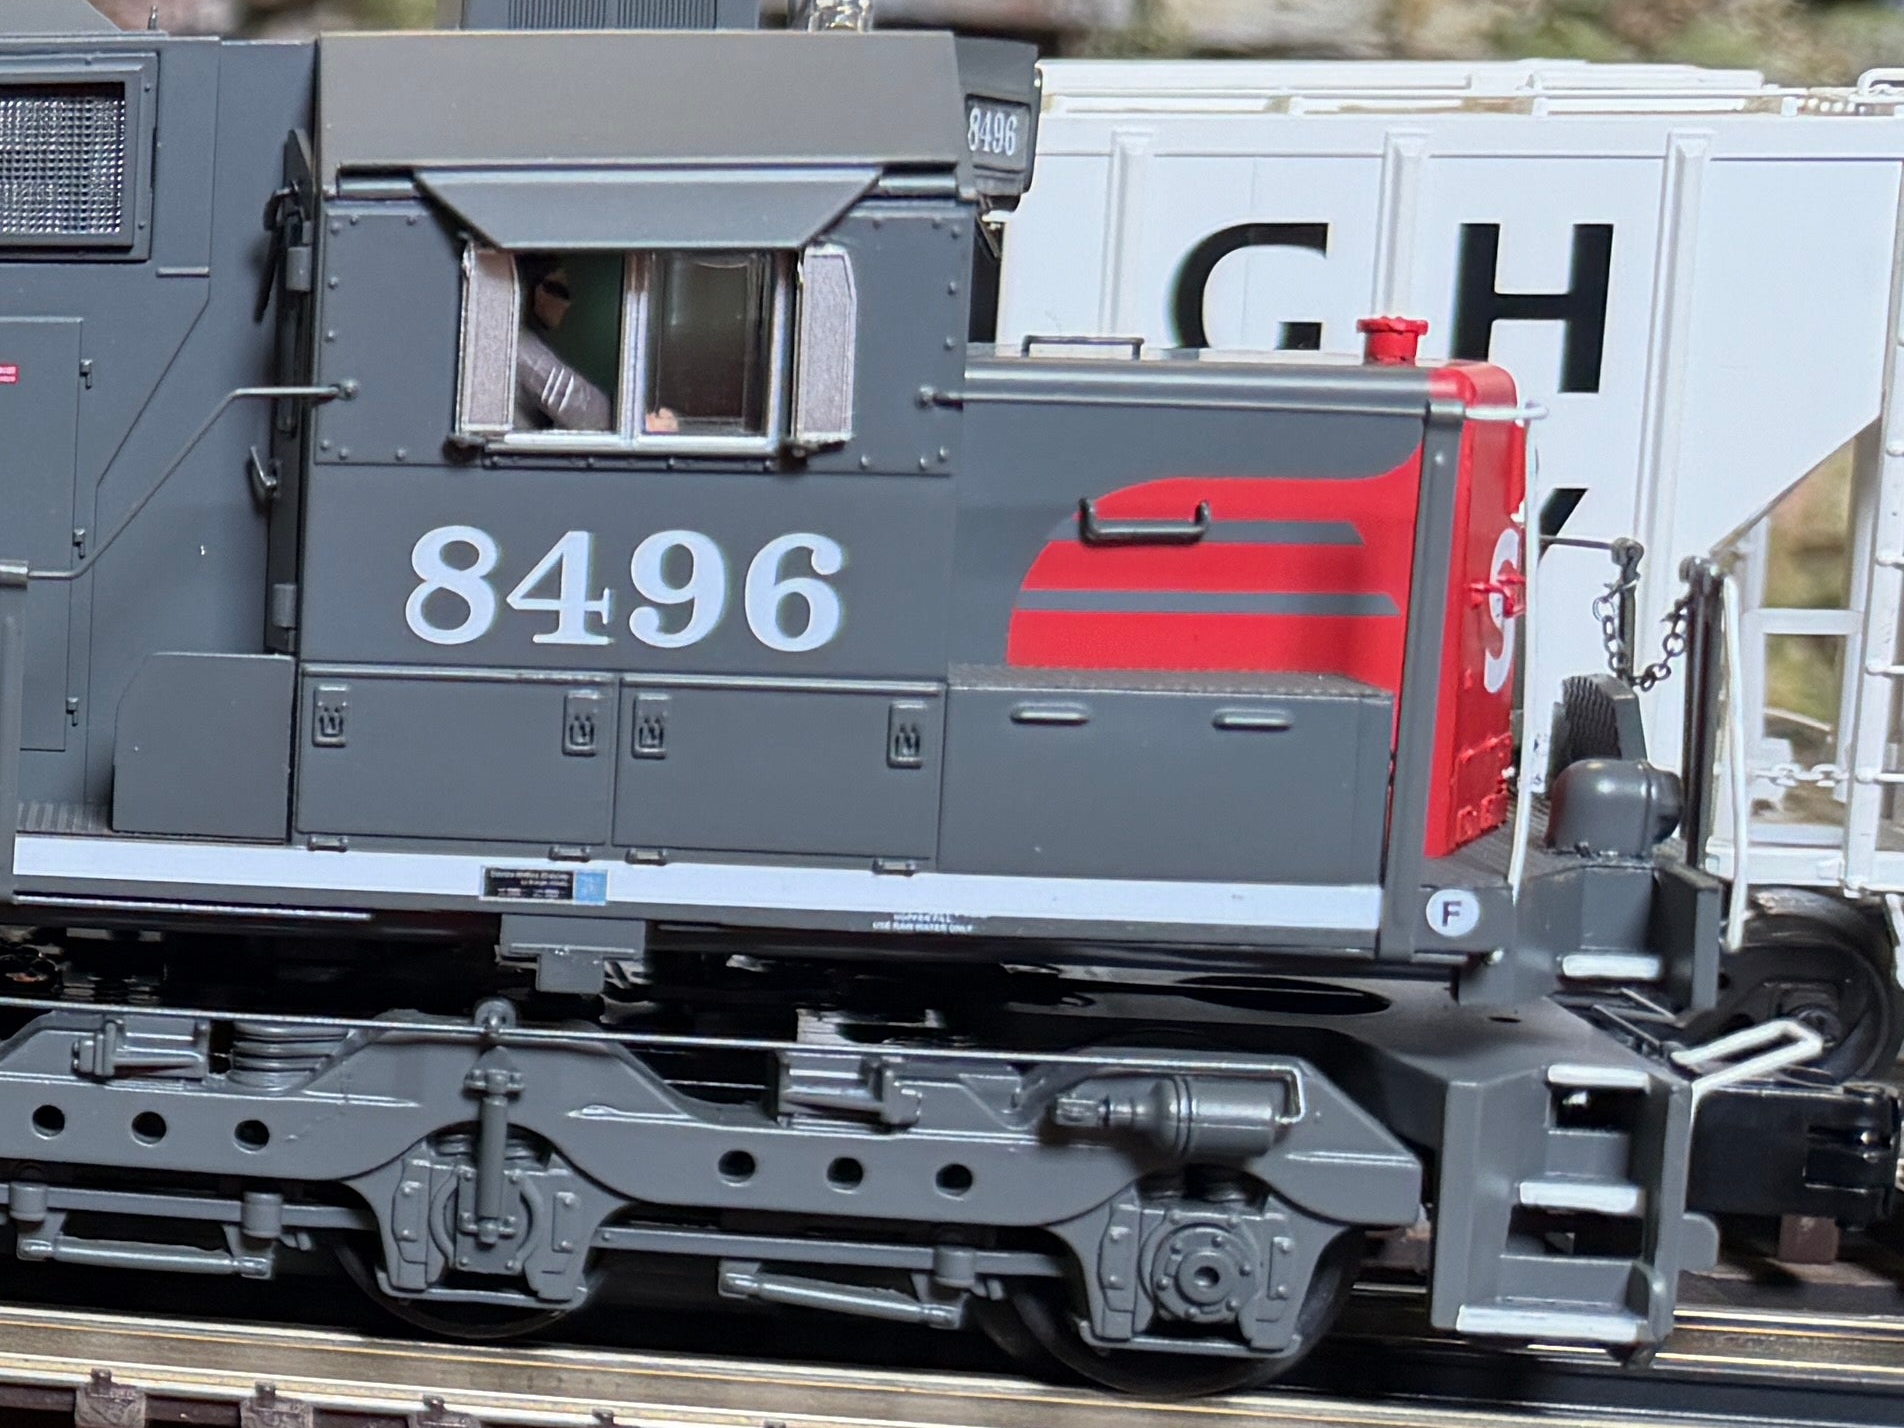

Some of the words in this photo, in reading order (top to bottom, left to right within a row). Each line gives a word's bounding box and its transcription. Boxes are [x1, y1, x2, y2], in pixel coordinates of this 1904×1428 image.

[967, 106, 1018, 157] 8496
[405, 525, 848, 653] 8496
[1441, 900, 1463, 927] F
